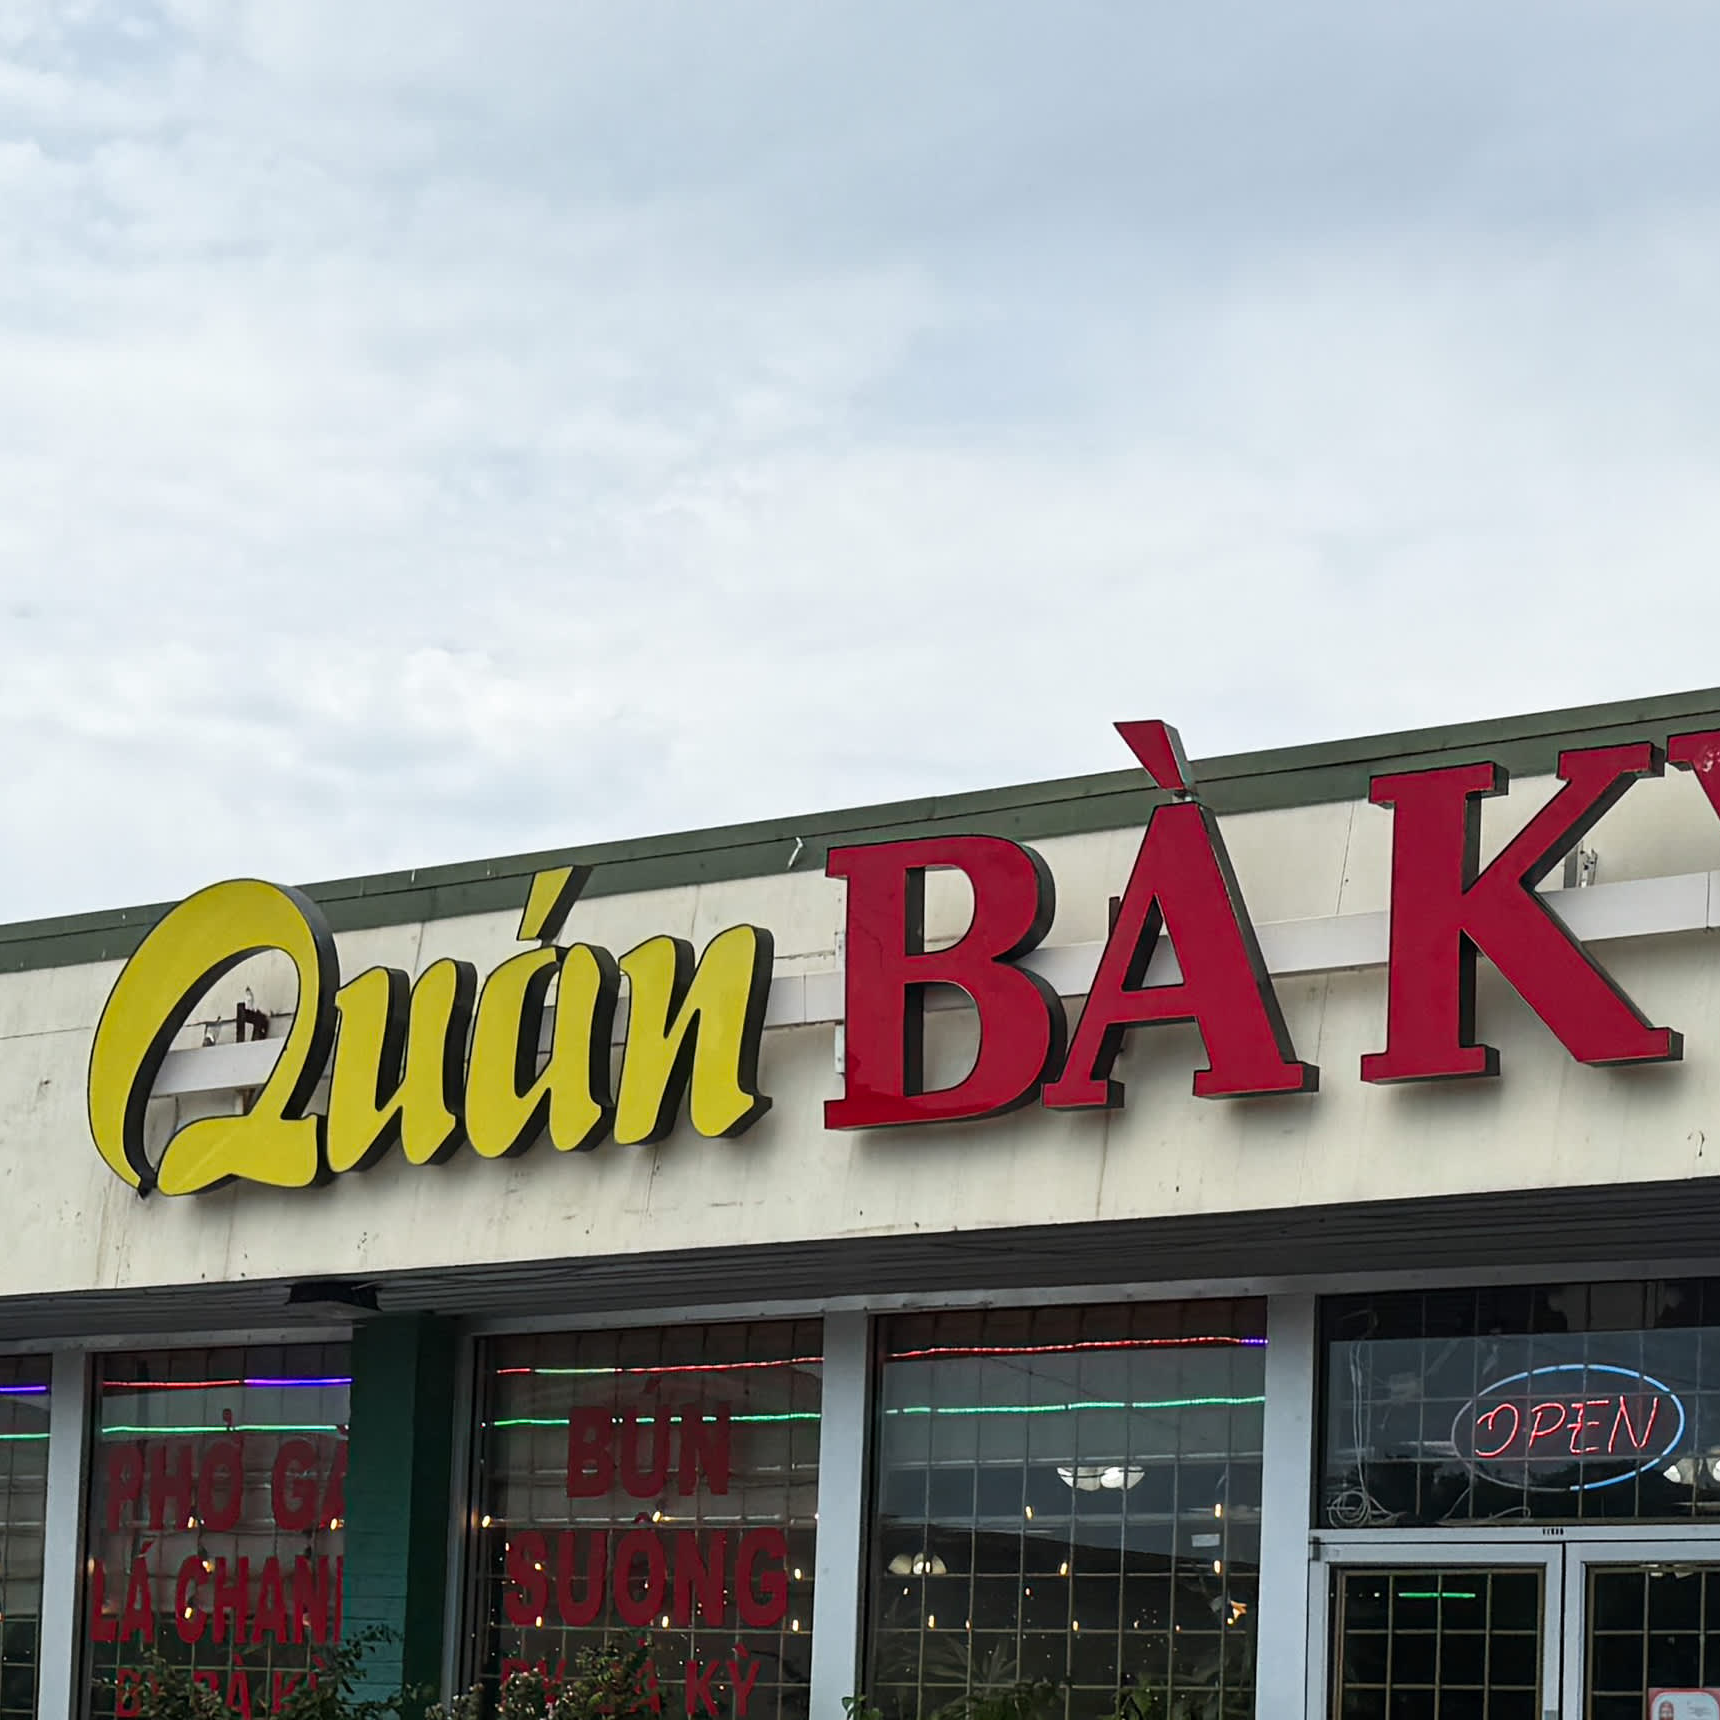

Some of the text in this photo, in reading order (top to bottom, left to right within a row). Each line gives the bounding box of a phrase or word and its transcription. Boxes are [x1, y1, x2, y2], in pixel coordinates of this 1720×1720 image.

[88, 866, 772, 1198] Quán
[825, 720, 1319, 1132] BÀ
[566, 1375, 731, 1498] BÚN
[1475, 1393, 1660, 1458] OPEN
[89, 1541, 345, 1645] LÁ CHAN
[685, 1642, 761, 1718] KỲ
